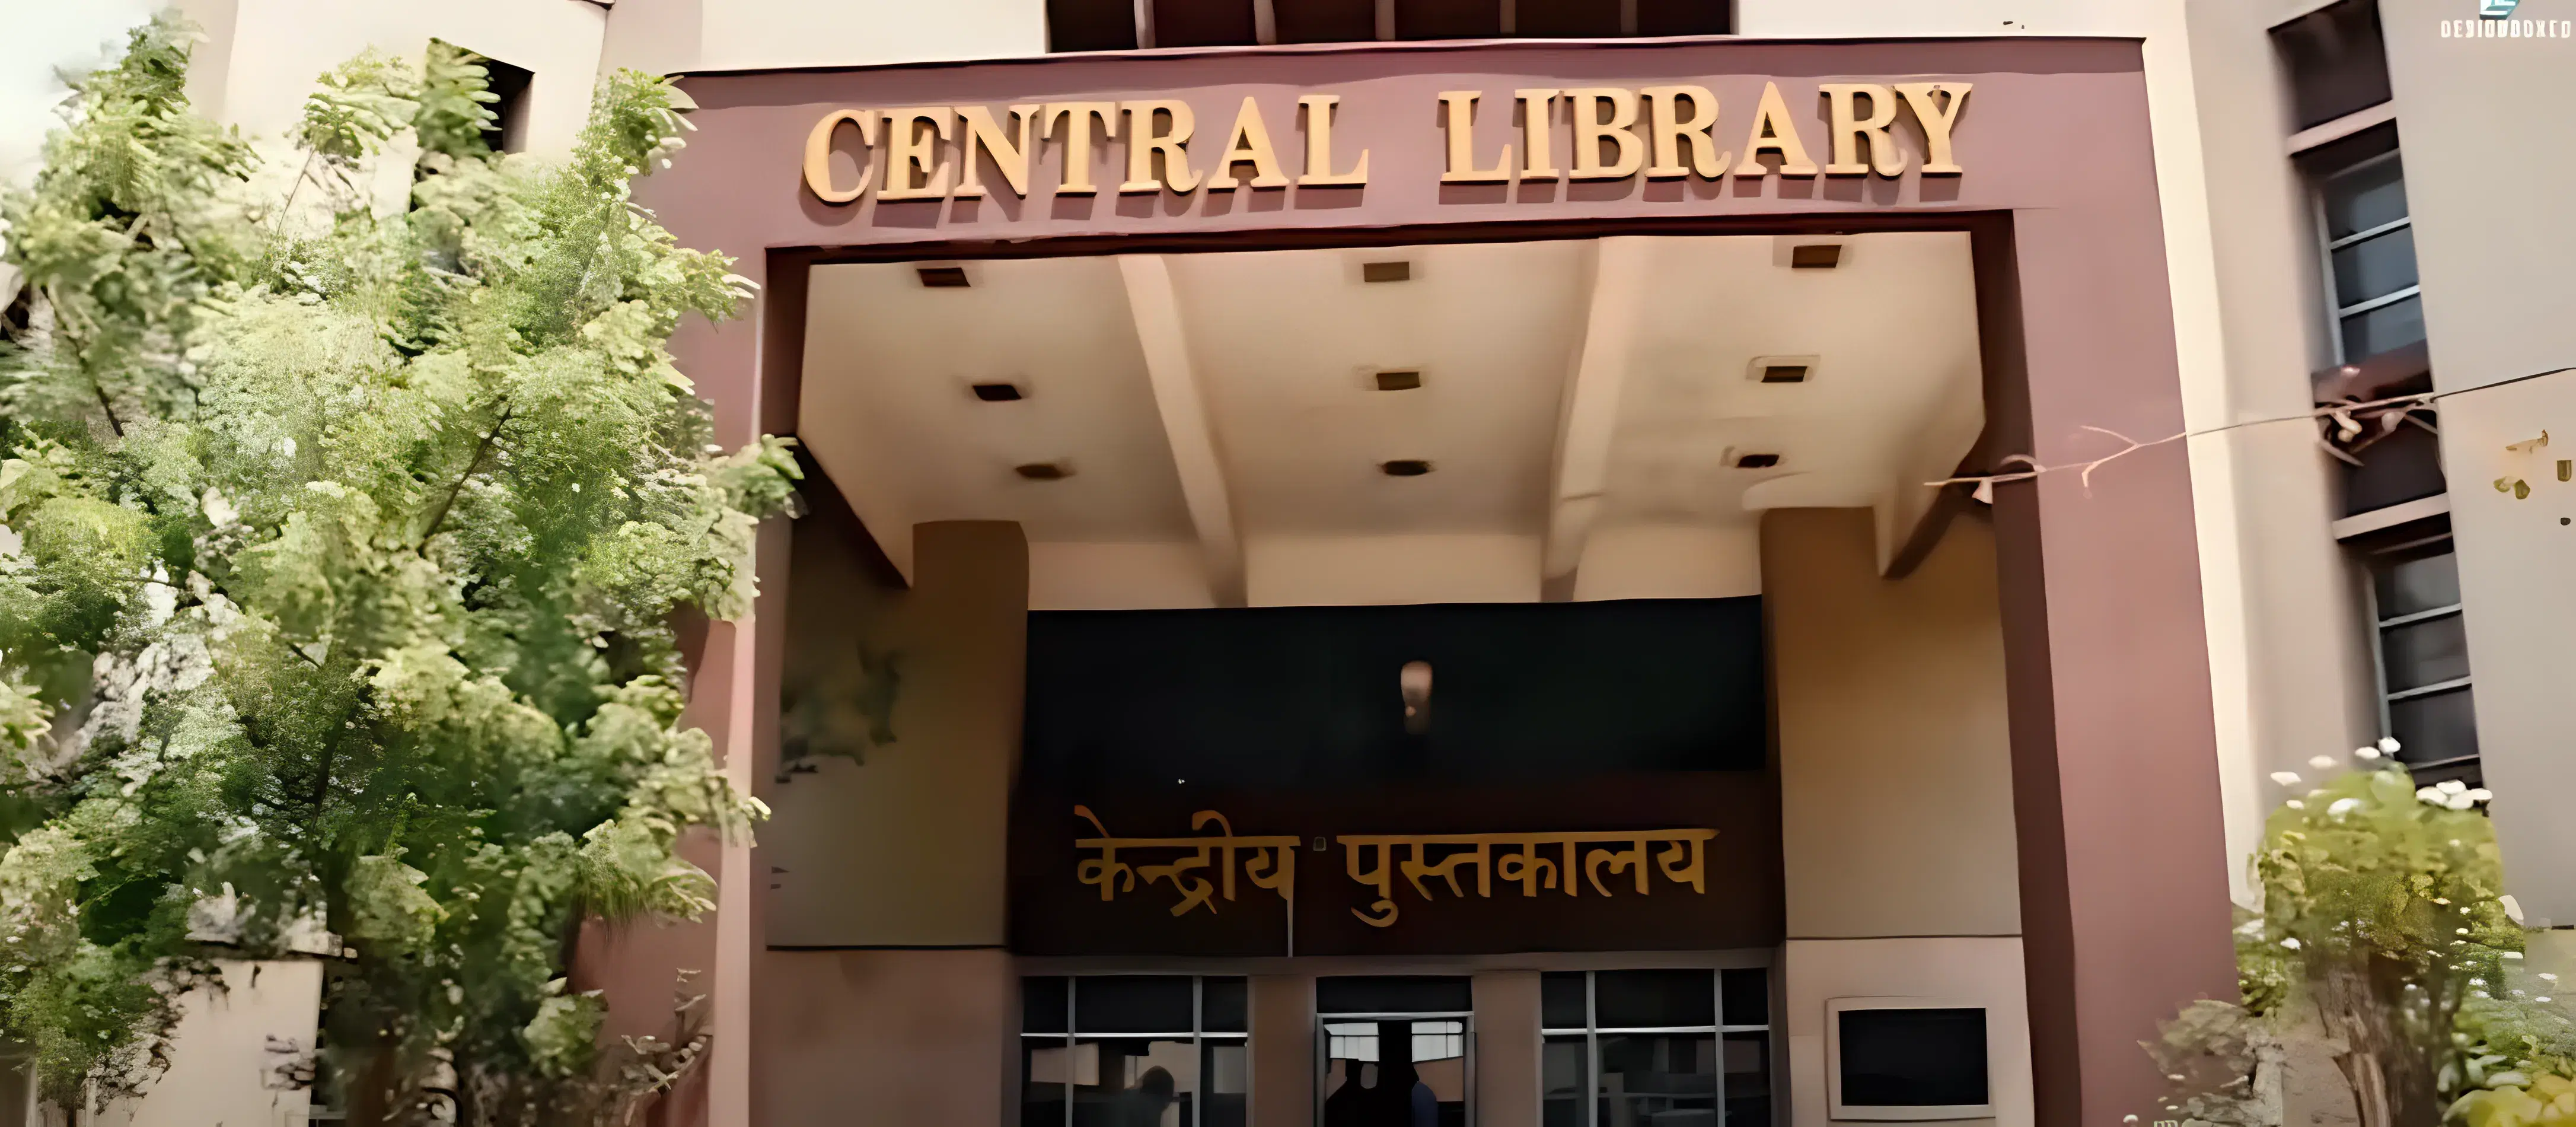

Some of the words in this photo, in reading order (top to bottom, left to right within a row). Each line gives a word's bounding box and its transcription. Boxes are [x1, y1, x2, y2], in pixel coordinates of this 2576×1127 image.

[802, 95, 1368, 204] CENTRAL
[1438, 81, 1974, 184] LIBRARY
[1075, 805, 1300, 917] केन्द्रीय
[1337, 828, 1720, 927] पुस्तकालय
